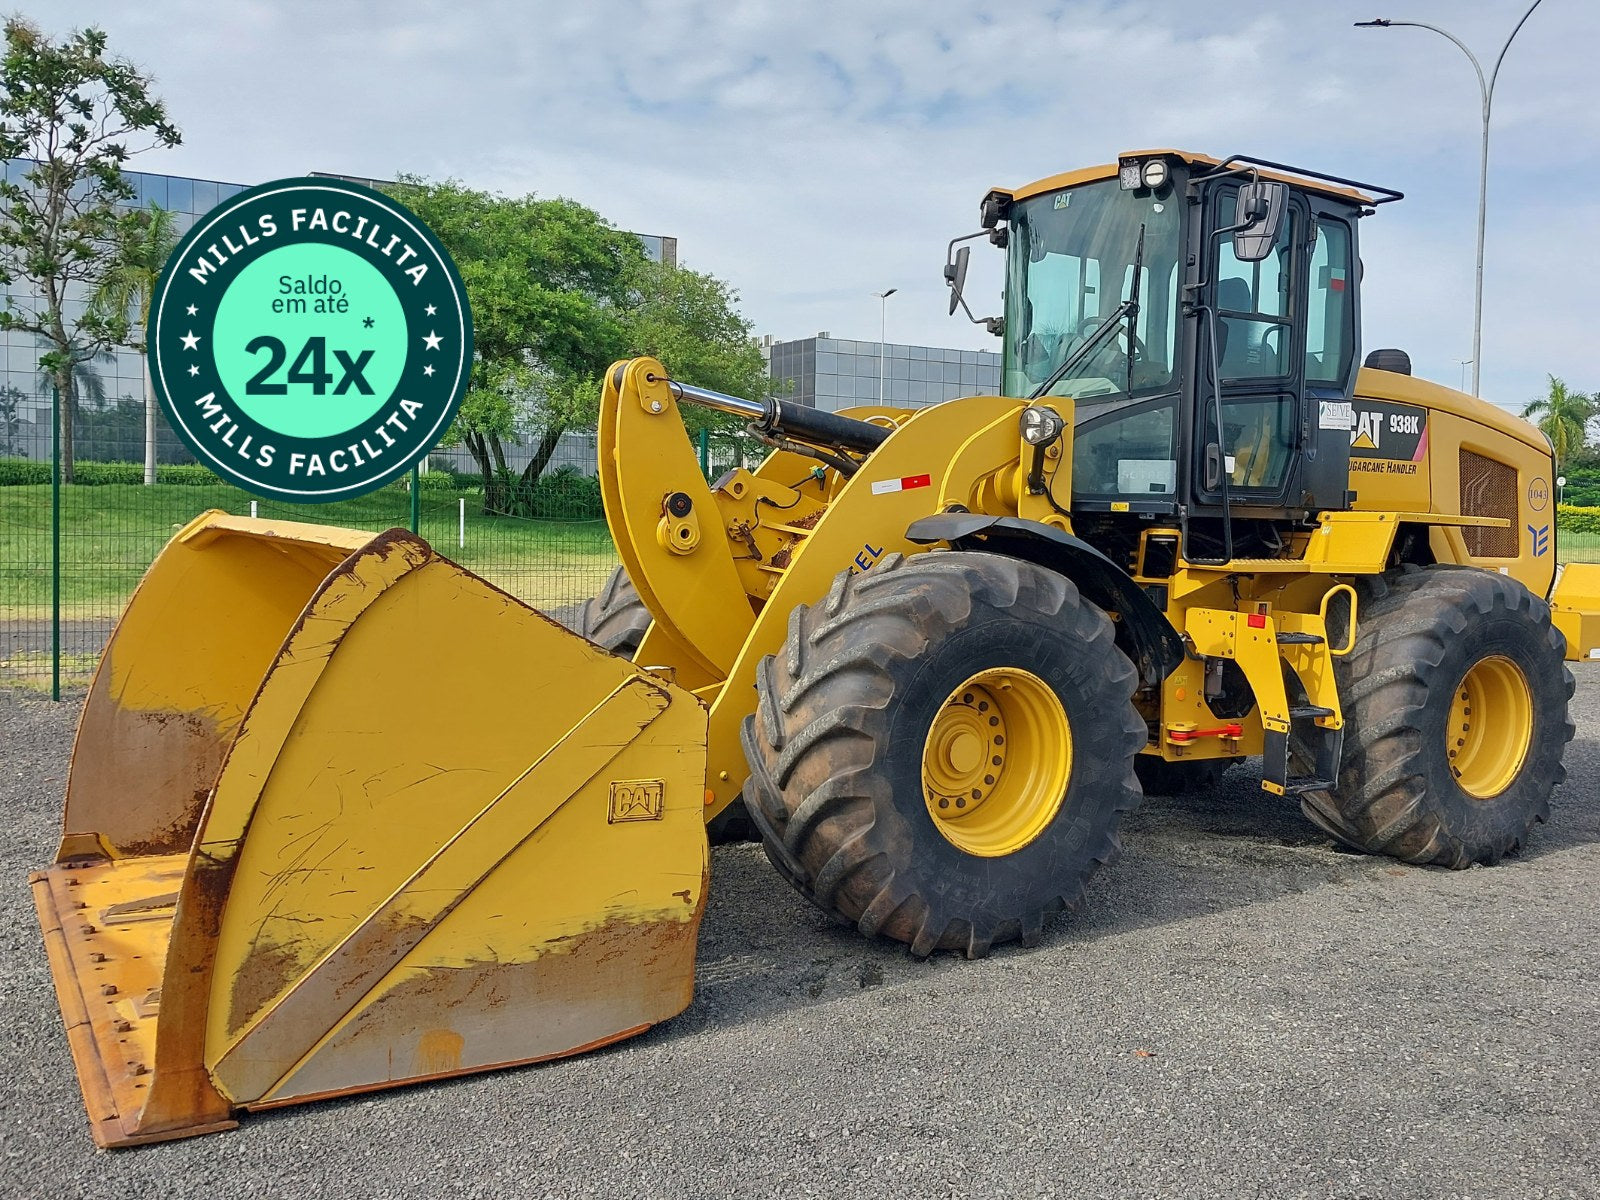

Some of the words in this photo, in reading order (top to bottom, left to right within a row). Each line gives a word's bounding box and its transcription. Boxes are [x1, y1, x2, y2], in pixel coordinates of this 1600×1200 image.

[1054, 192, 1072, 209] CAT
[1389, 414, 1419, 434] 938K
[1349, 461, 1385, 473] UGARCANE
[1530, 489, 1547, 500] 1043
[614, 786, 661, 817] CAT
